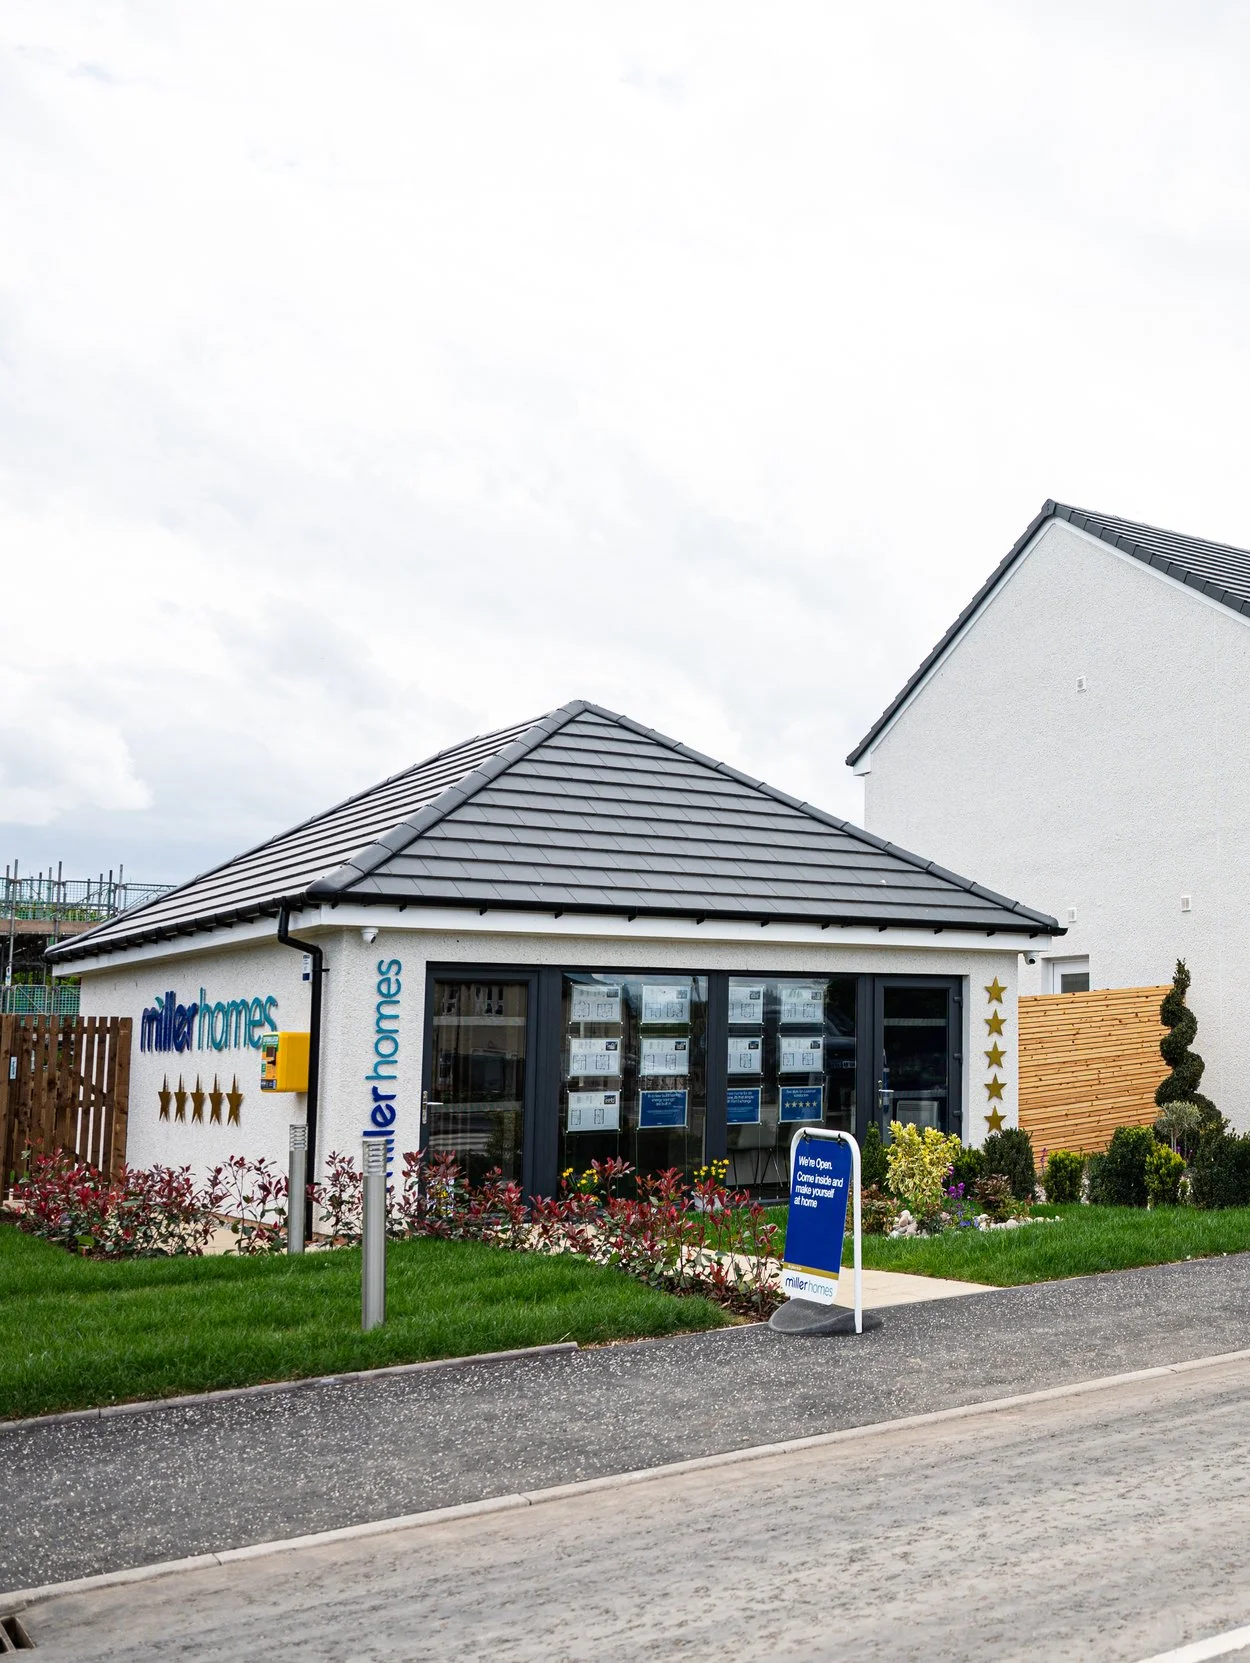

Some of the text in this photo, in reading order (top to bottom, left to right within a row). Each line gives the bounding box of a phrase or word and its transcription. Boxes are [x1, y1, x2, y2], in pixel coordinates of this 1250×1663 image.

[798, 1155, 833, 1170] We're Open.
[797, 1171, 844, 1188] Come inside and
[795, 1184, 836, 1199] make yourself
[793, 1195, 818, 1208] at home
